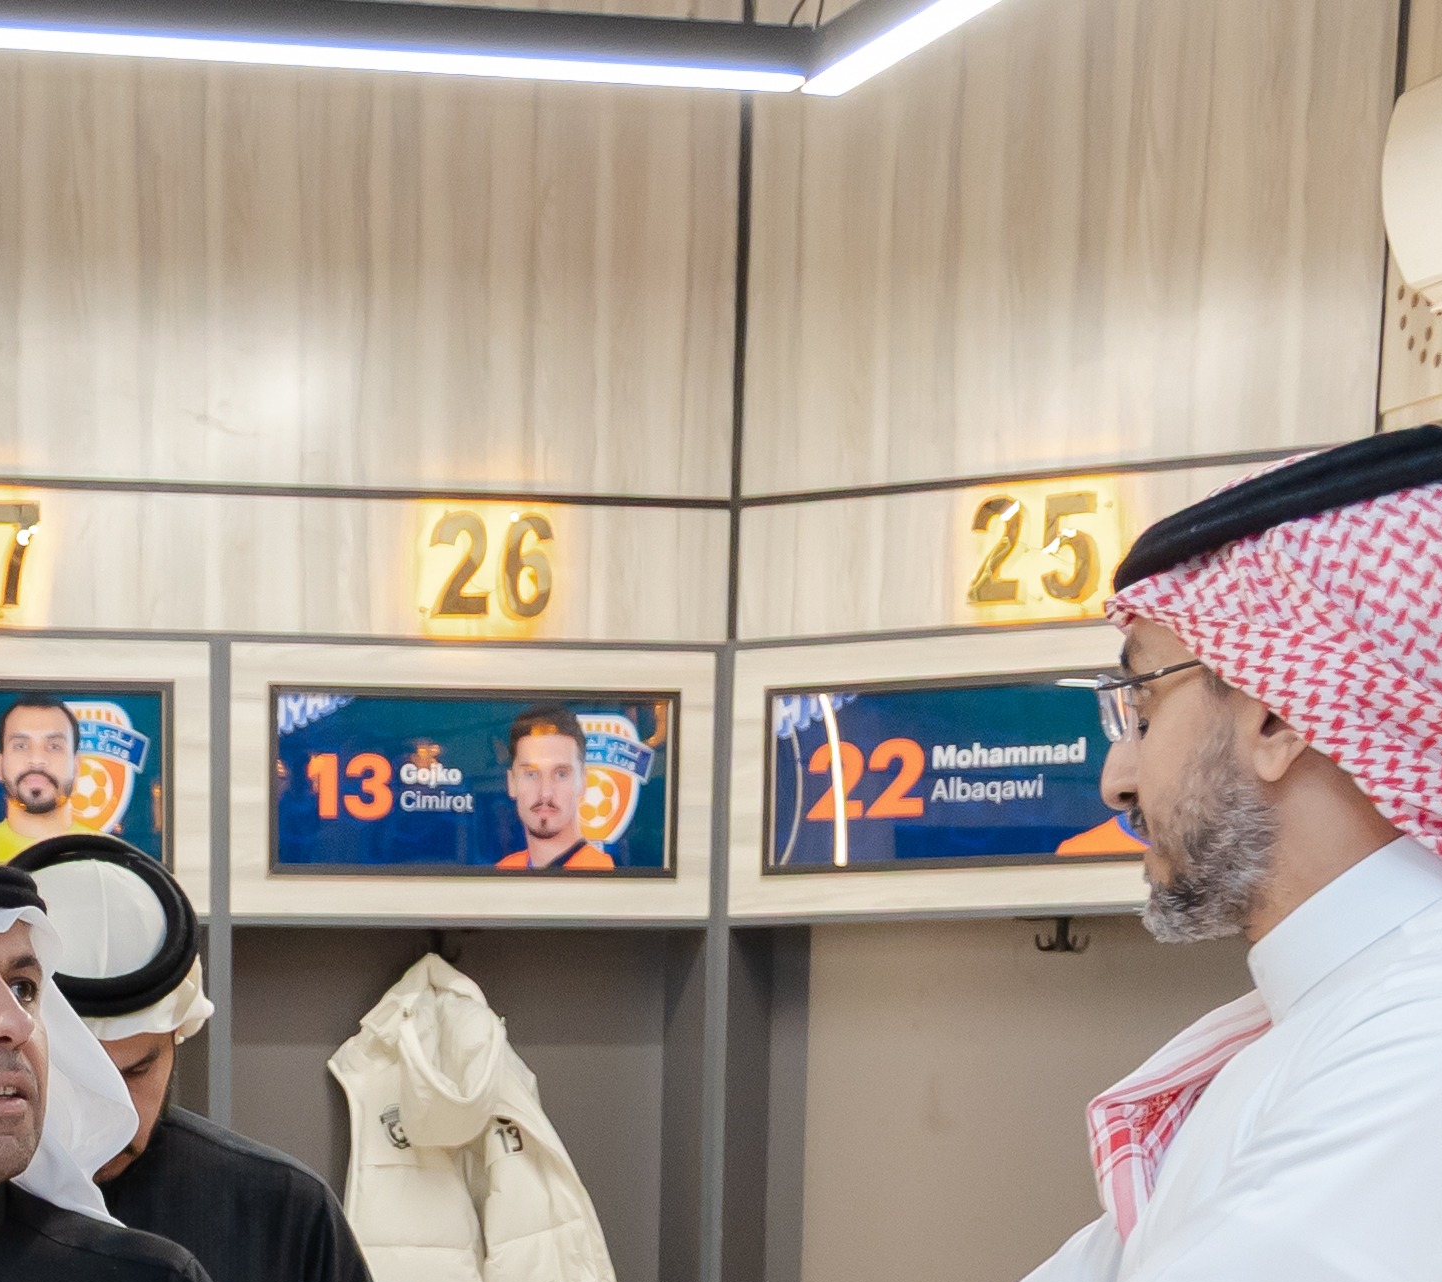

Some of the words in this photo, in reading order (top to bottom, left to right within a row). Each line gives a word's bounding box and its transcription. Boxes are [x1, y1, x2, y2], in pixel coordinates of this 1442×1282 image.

[430, 510, 554, 619] 26
[969, 491, 1099, 604] 25
[307, 753, 393, 820] 13
[400, 762, 462, 788] Gojko
[400, 790, 474, 813] Cimirot
[806, 738, 925, 821] 22
[932, 736, 1087, 770] Mohammad
[930, 774, 1044, 804] Albaqawi
